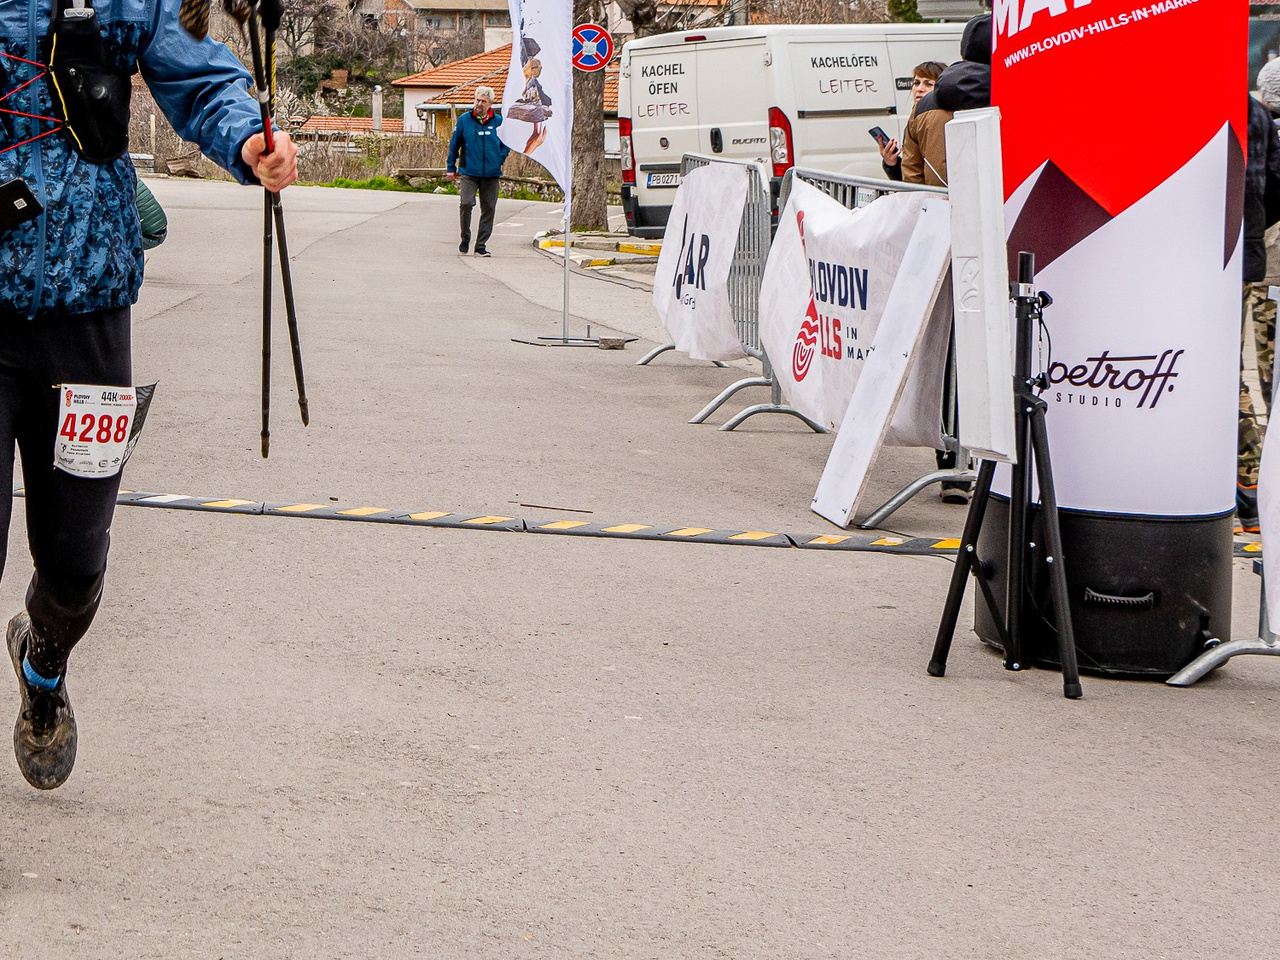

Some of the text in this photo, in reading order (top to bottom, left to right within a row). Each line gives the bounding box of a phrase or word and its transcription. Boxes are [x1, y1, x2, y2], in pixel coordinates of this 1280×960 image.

[810, 53, 879, 68] KACHELÖFEN
[641, 63, 686, 78] KACHEL
[648, 81, 678, 96] ÖFEN
[819, 78, 878, 94] LEITER
[637, 102, 691, 118] LEITER
[732, 137, 767, 145] DUCATO
[661, 174, 678, 185] 0271
[846, 326, 858, 340] IN
[101, 391, 118, 402] 44K
[1055, 392, 1123, 408] STUDIO
[60, 413, 129, 443] 4288
